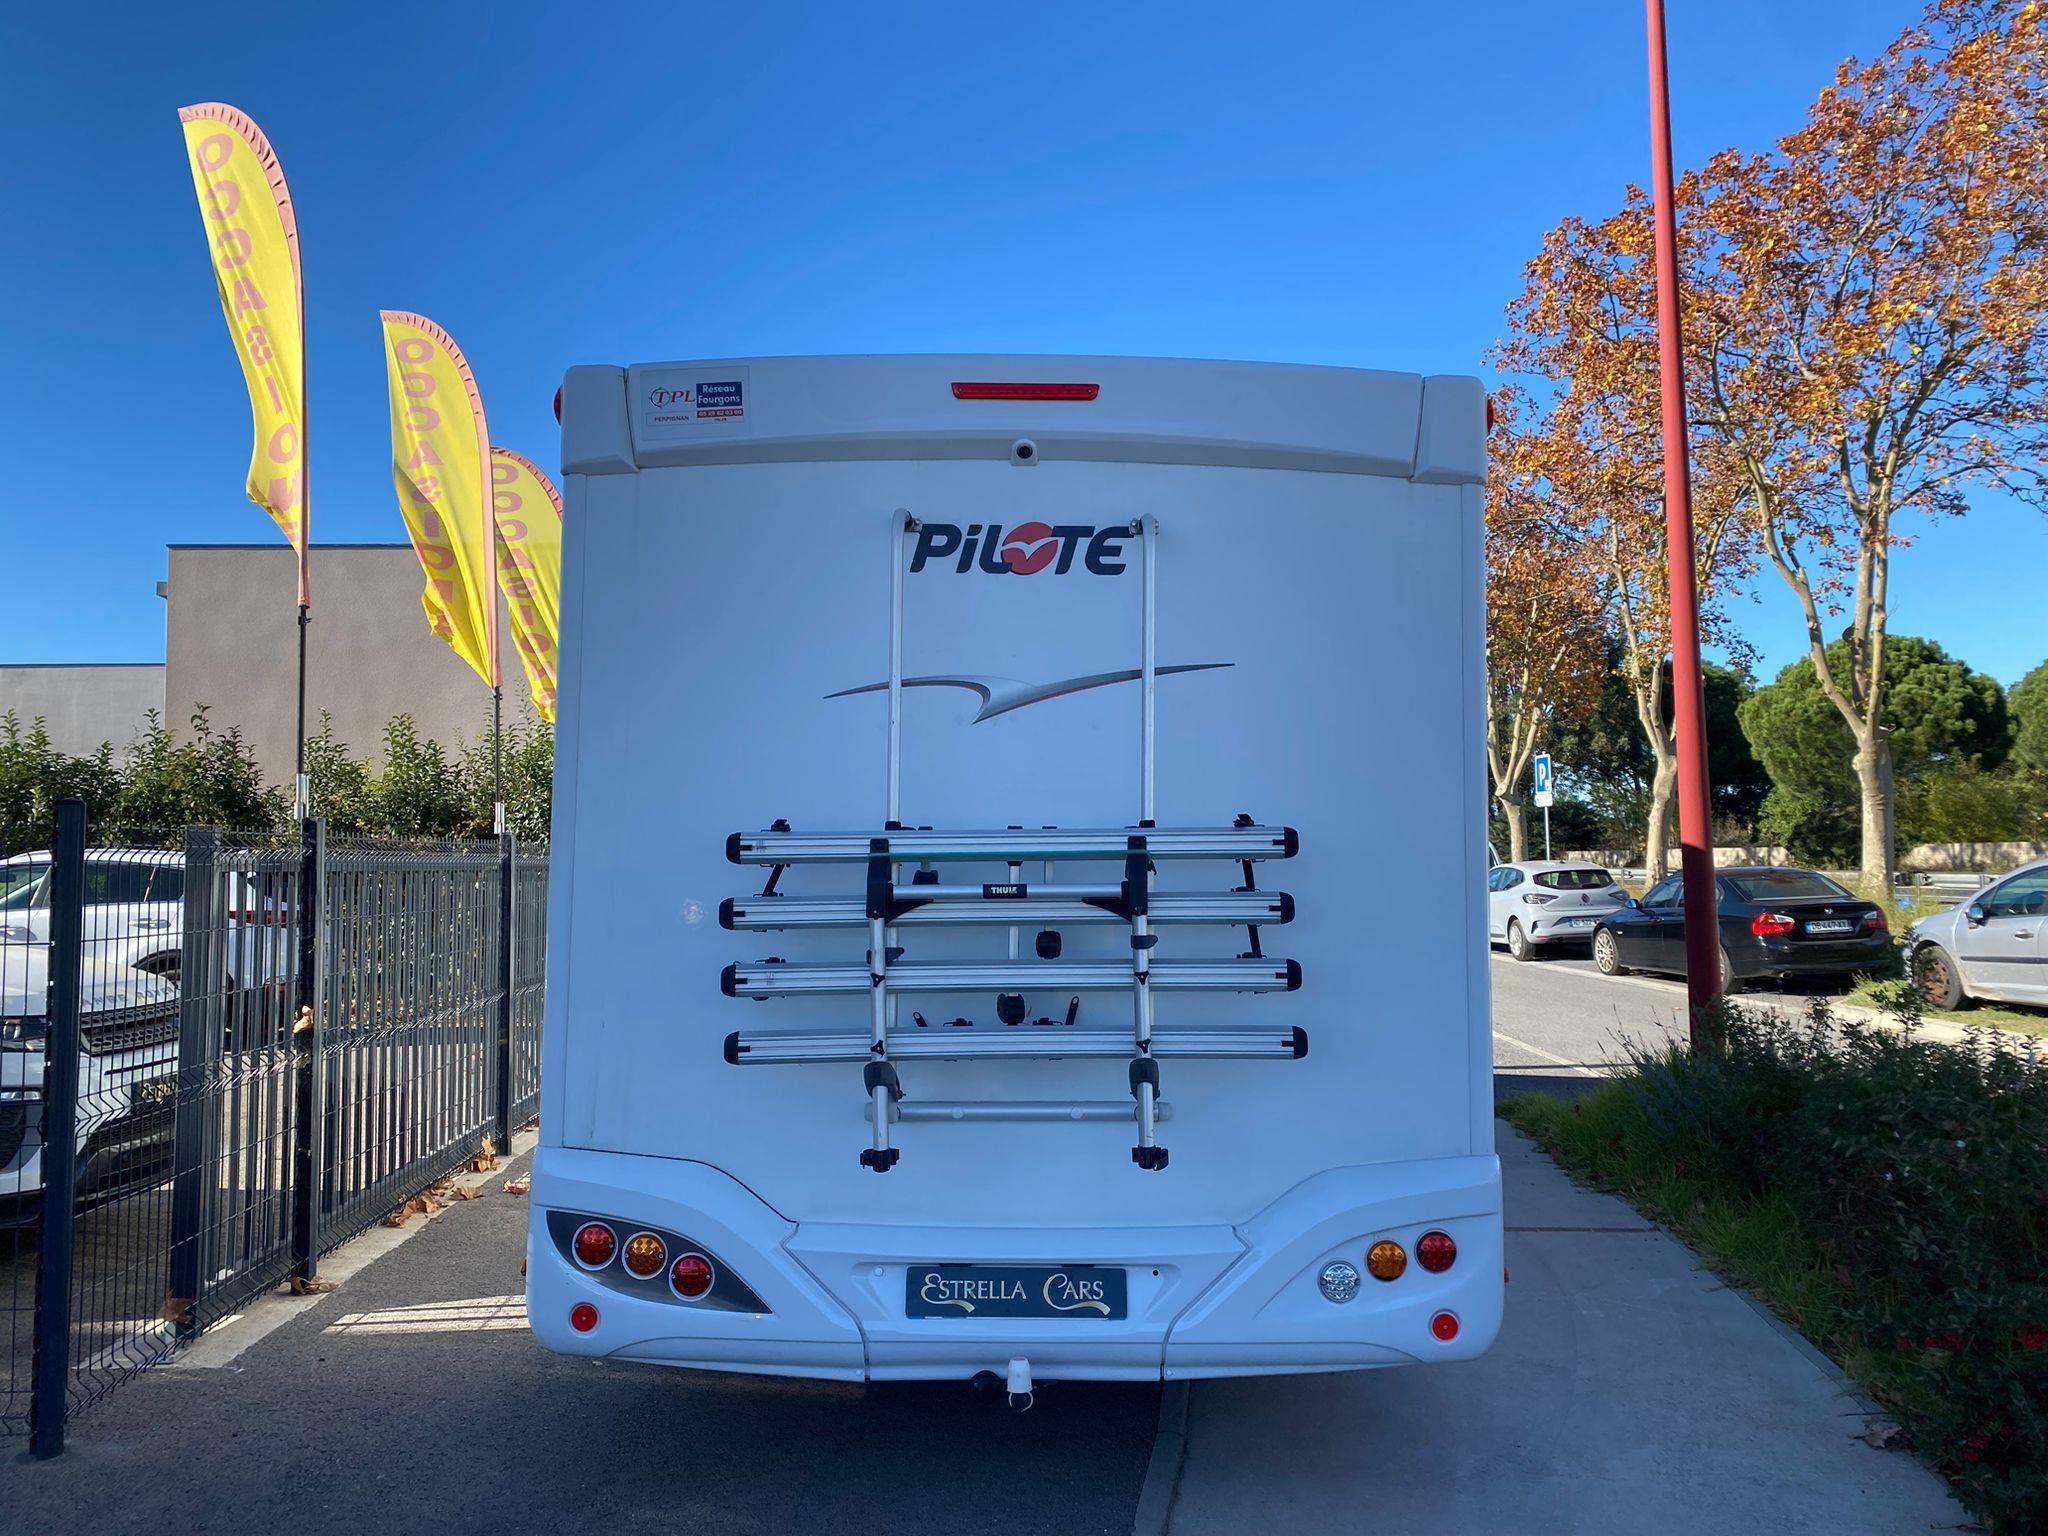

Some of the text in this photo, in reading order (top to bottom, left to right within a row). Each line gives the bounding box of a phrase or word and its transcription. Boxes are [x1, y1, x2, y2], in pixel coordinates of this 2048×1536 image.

[702, 384, 736, 394] Réseau
[654, 390, 696, 404] TPL
[697, 395, 741, 405] Fourgons
[654, 415, 690, 423] PERPIGNAN
[1538, 762, 1547, 787] P
[990, 886, 1018, 894] THULE
[920, 1273, 1111, 1316] ESTRELLA CARS
